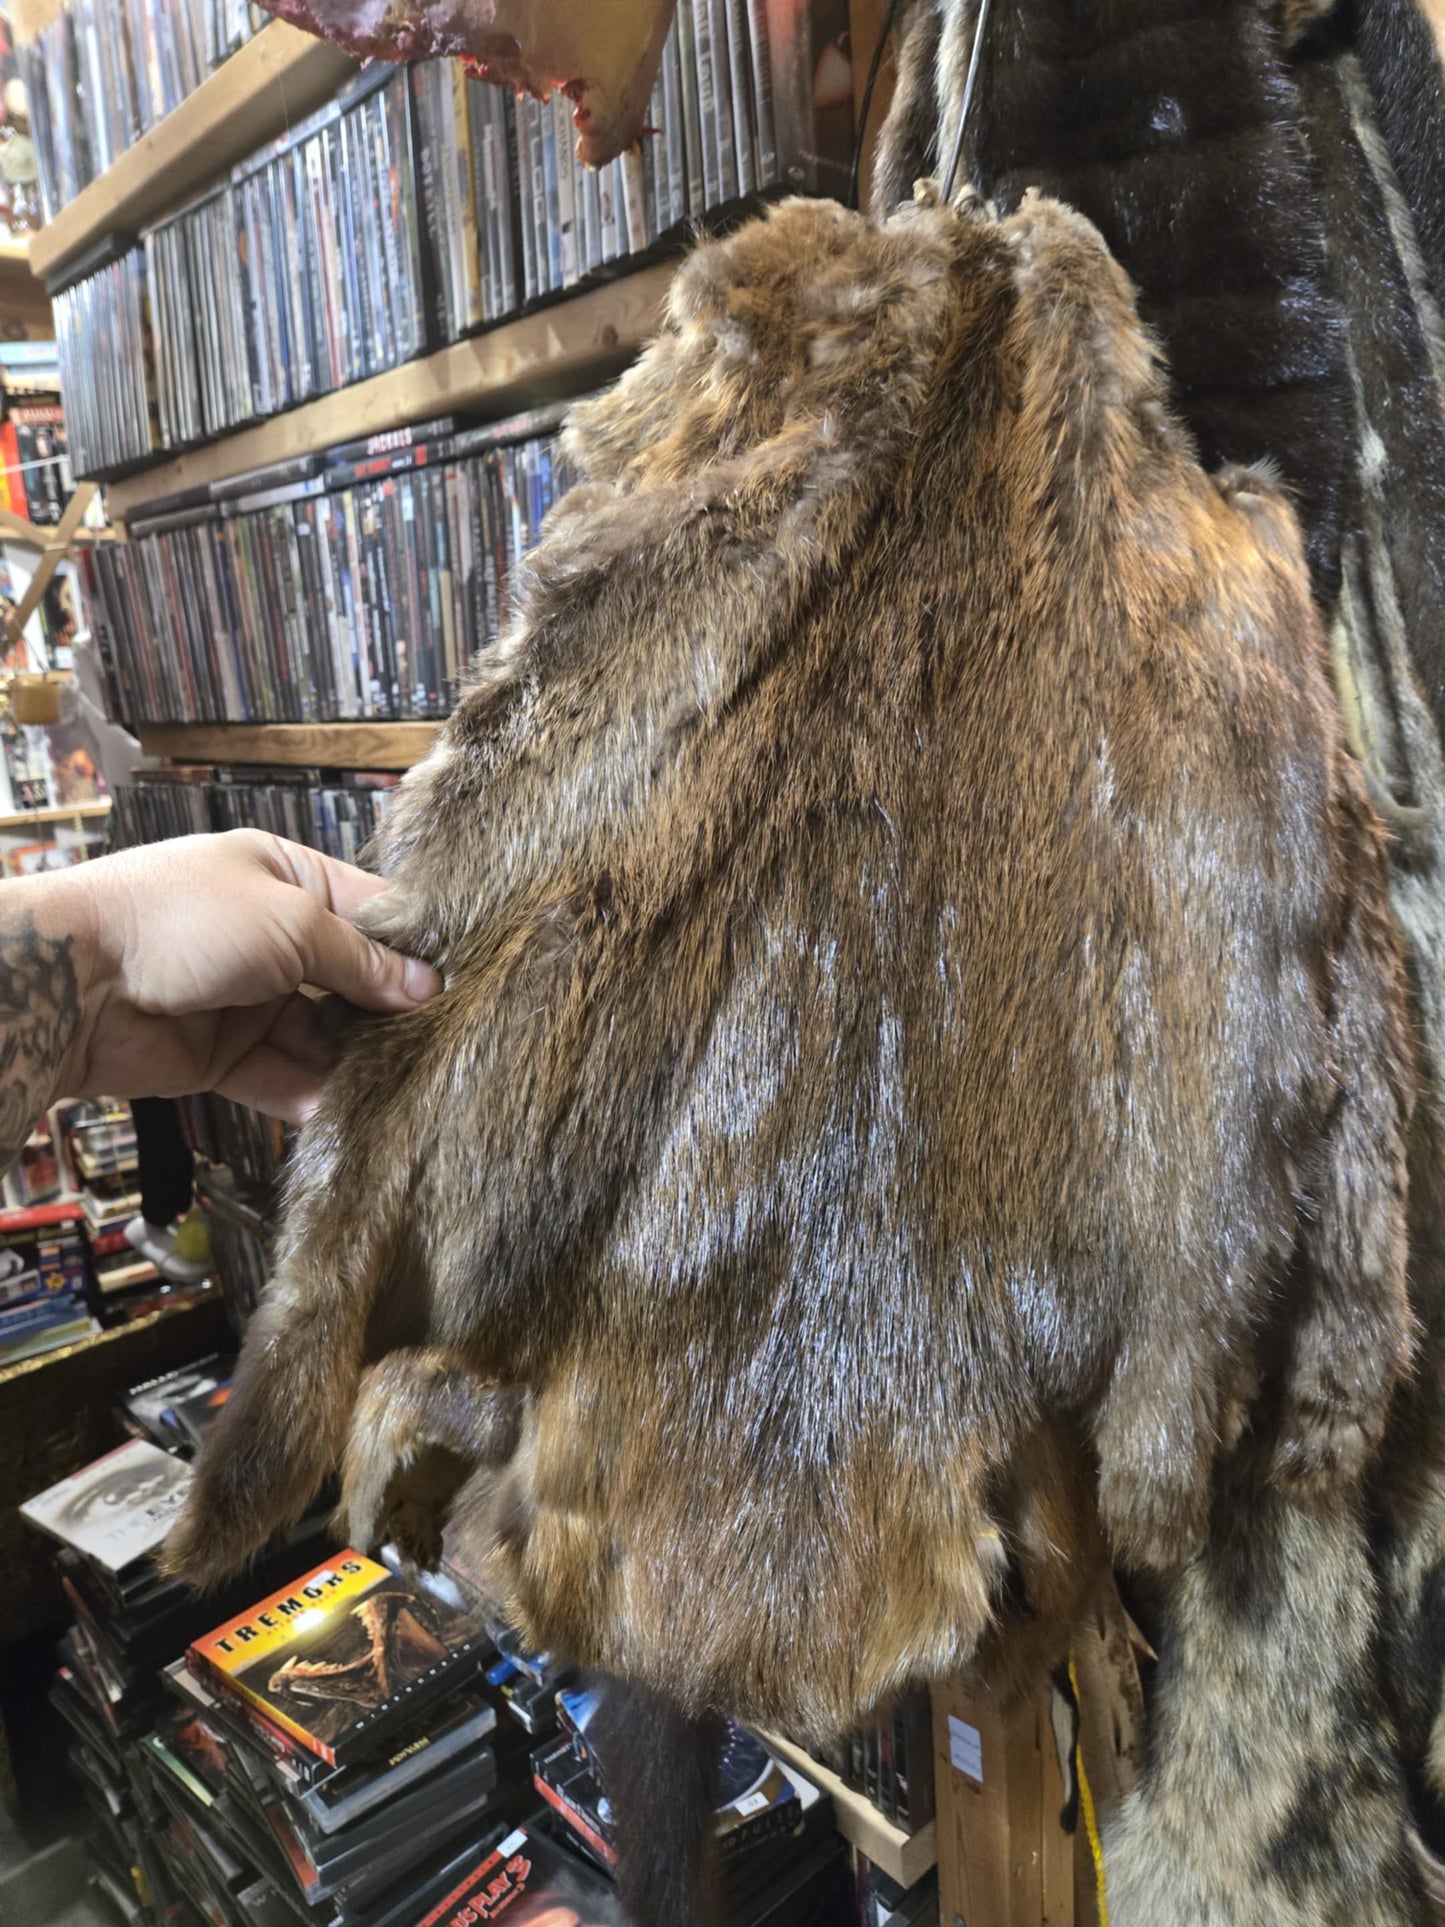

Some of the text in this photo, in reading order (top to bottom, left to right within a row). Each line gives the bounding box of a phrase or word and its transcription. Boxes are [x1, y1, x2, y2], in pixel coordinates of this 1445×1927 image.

[213, 1560, 362, 1654] TREMORS
[467, 1871, 512, 1919] PLAY
[504, 1854, 533, 1882] 3
